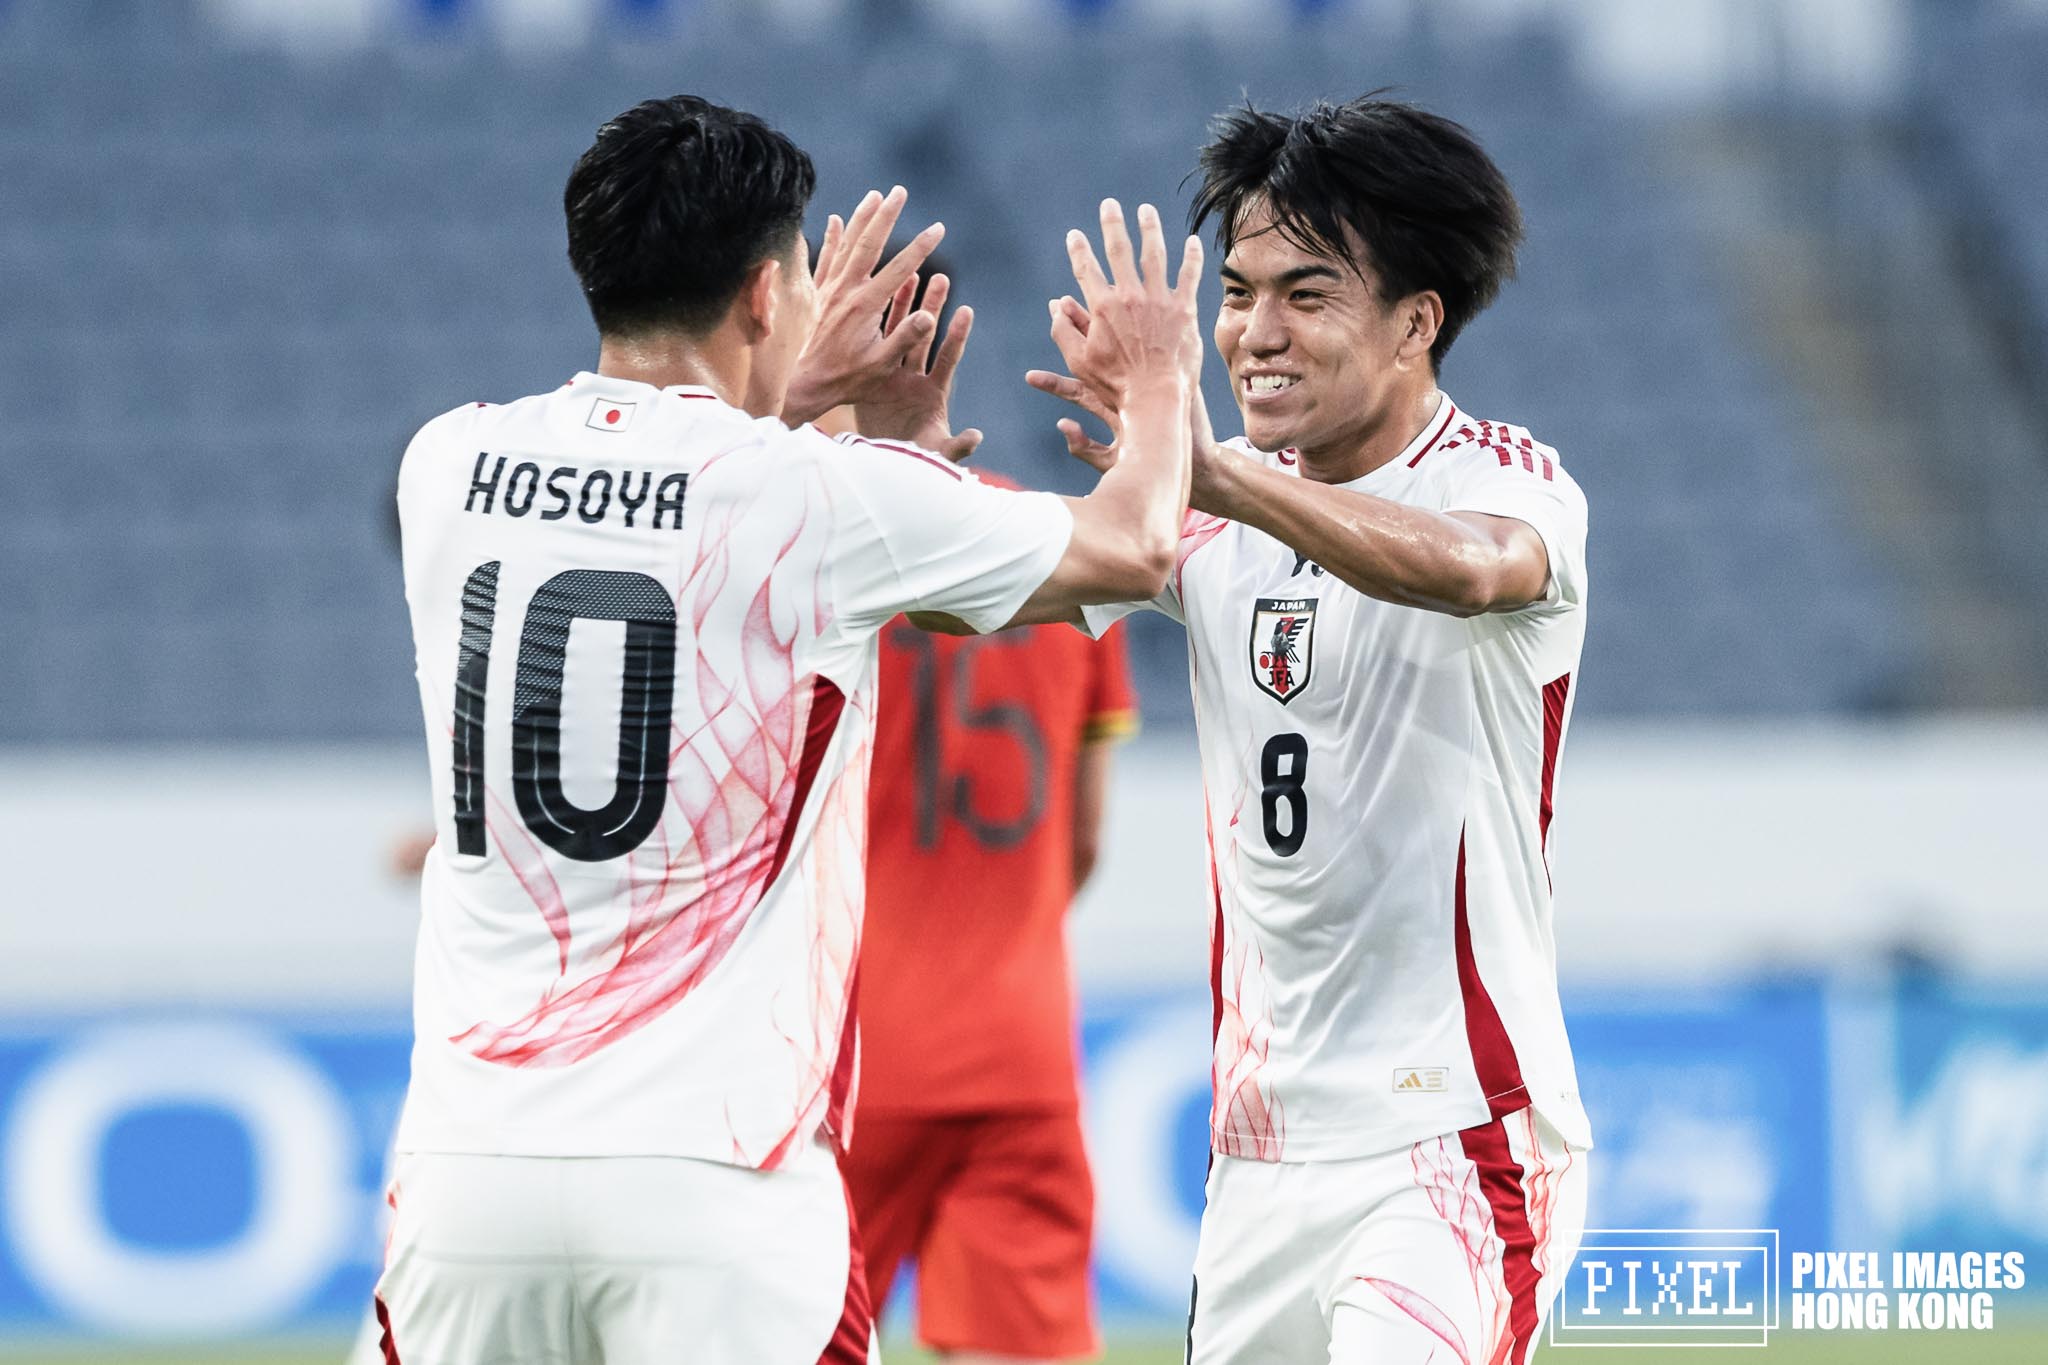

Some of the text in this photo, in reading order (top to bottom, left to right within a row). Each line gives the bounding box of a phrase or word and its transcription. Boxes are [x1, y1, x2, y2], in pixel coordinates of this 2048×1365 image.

[464, 451, 690, 530] HOSOYA
[1271, 601, 1305, 611] JAPAN
[453, 560, 677, 863] 10
[1268, 672, 1295, 686] JFA
[890, 626, 1048, 853] 15
[1260, 732, 1309, 858] 8
